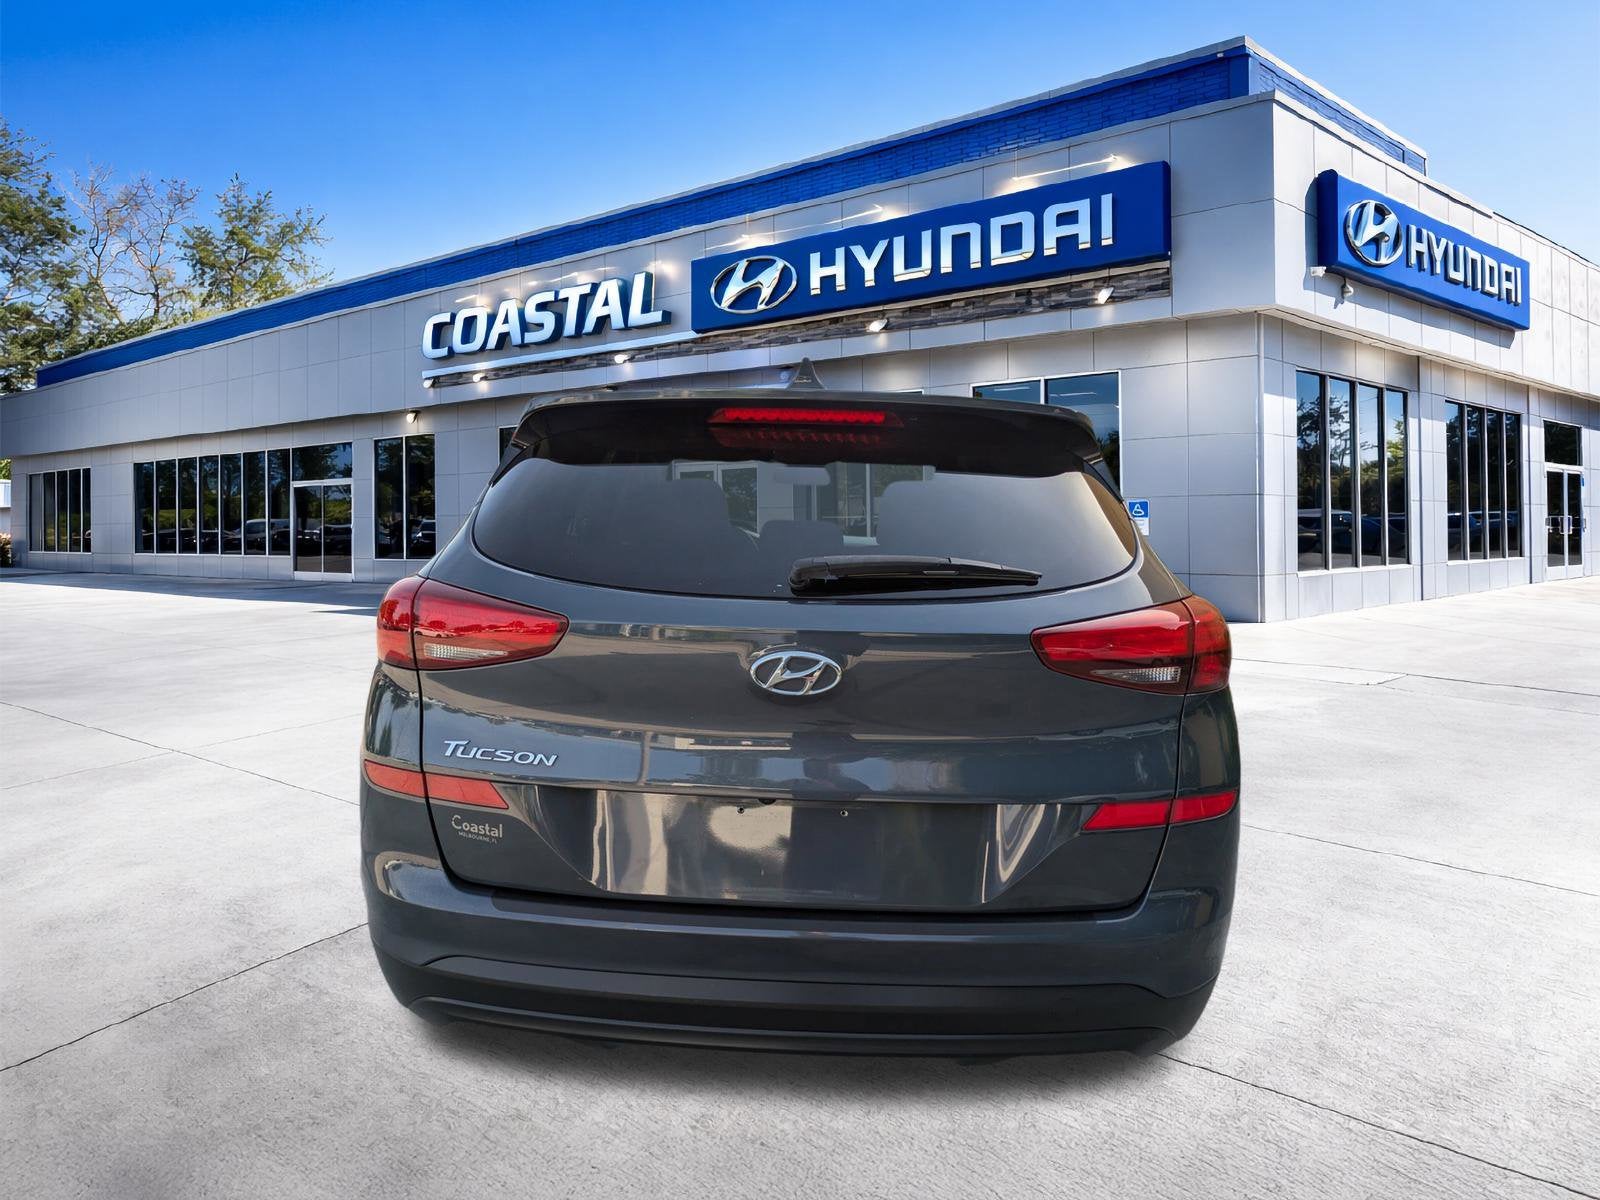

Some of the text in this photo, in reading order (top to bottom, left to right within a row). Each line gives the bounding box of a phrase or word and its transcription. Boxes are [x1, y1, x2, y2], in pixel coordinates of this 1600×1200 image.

[809, 193, 1114, 296] HYUNDAI
[1407, 224, 1522, 305] HYUNDAI
[422, 271, 668, 360] COASTAL
[451, 814, 503, 838] Coastal
